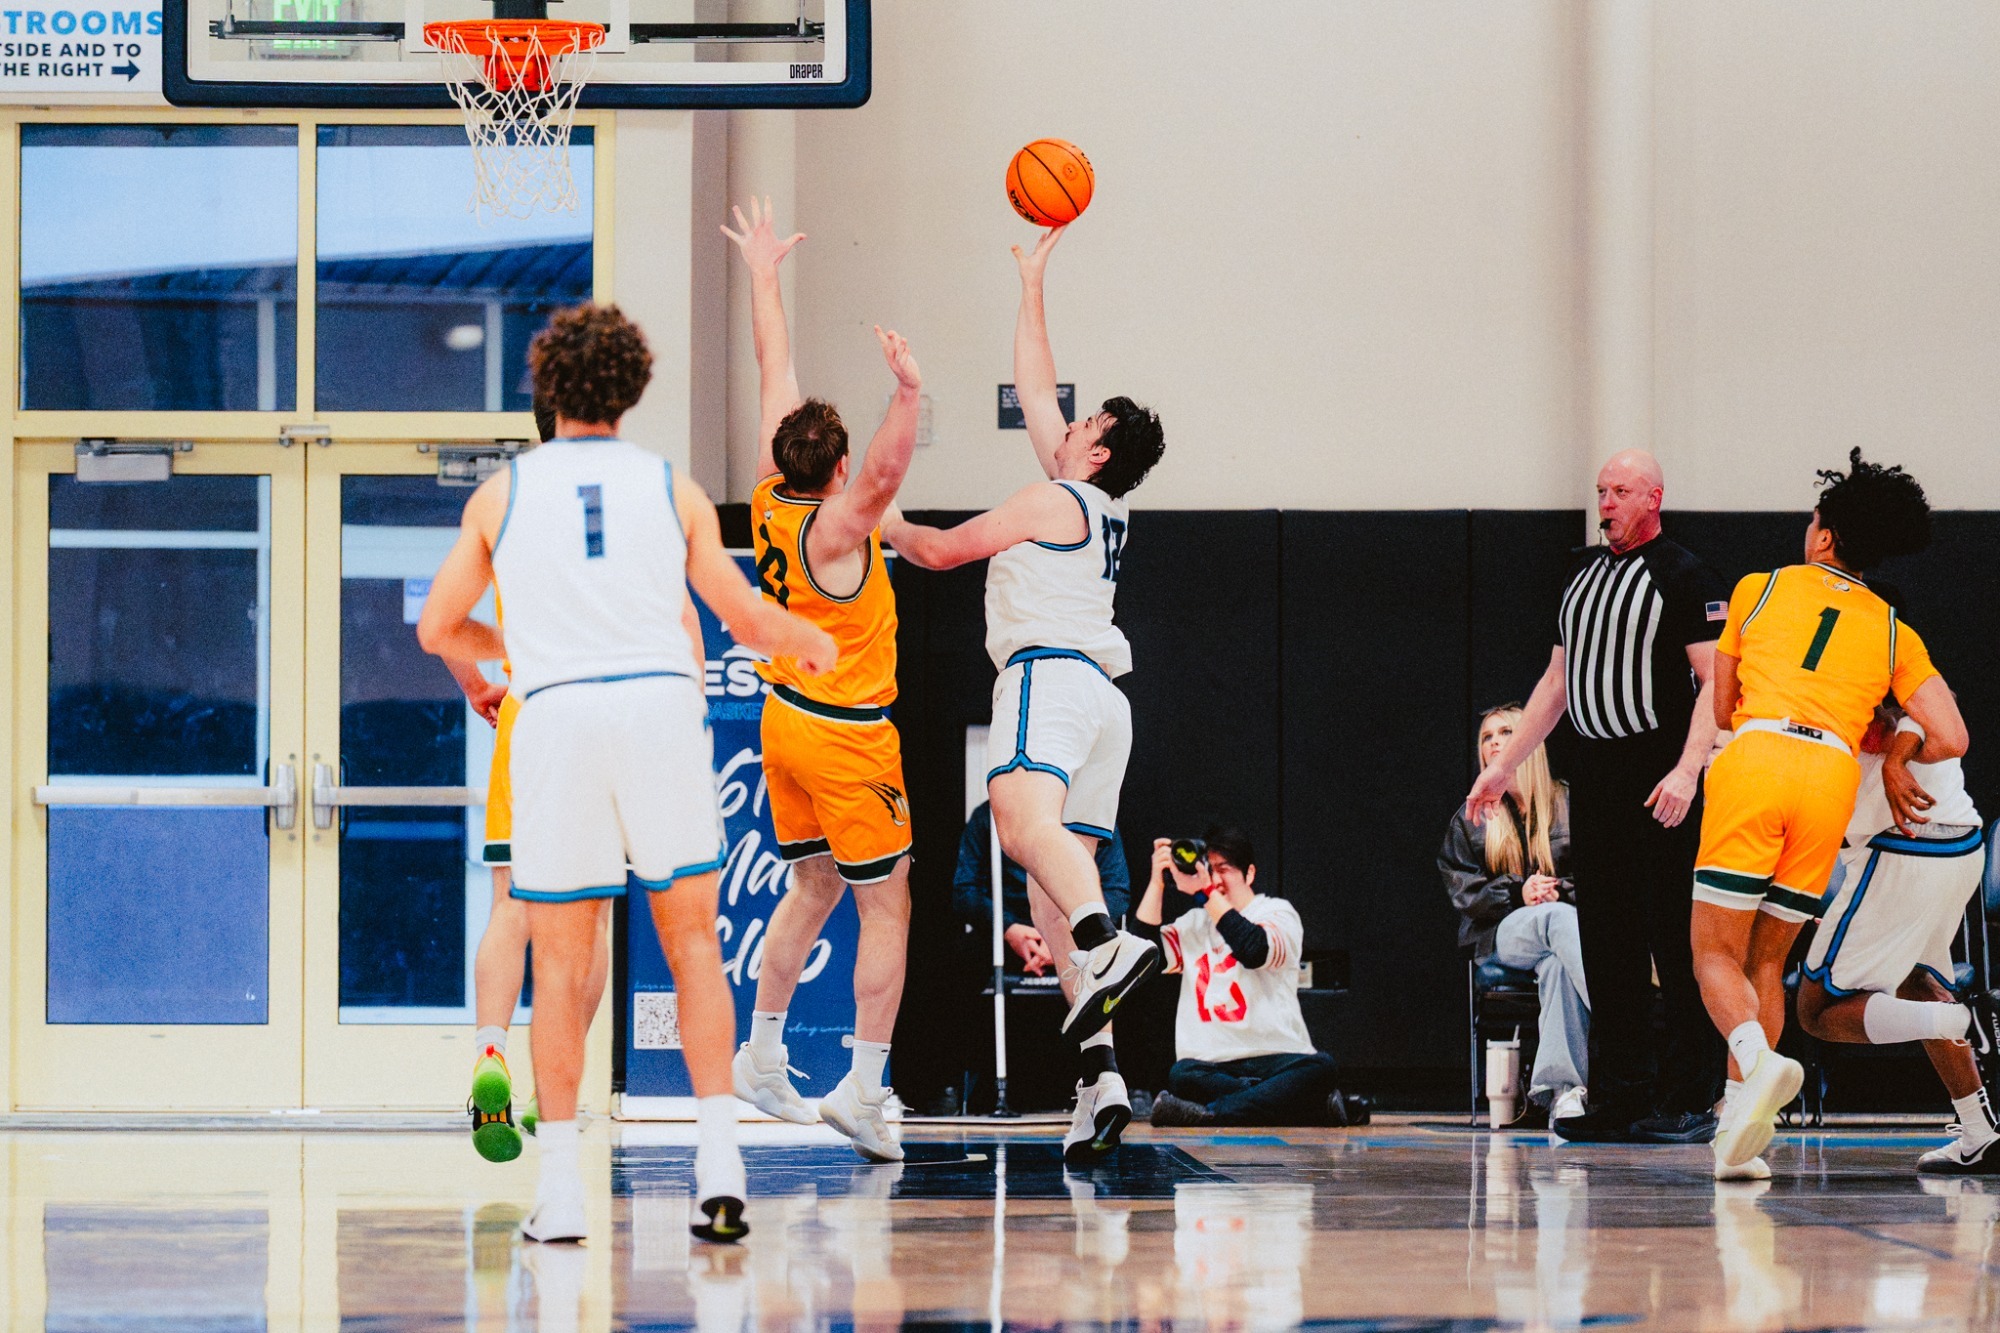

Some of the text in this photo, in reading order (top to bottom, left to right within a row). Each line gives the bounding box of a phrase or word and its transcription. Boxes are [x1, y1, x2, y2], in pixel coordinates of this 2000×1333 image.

[3, 10, 163, 36] TROOMS
[0, 43, 141, 57] SIDE AND TO
[0, 62, 104, 77] HE RIGHT
[577, 484, 605, 559] 1
[1800, 606, 1841, 673] 1
